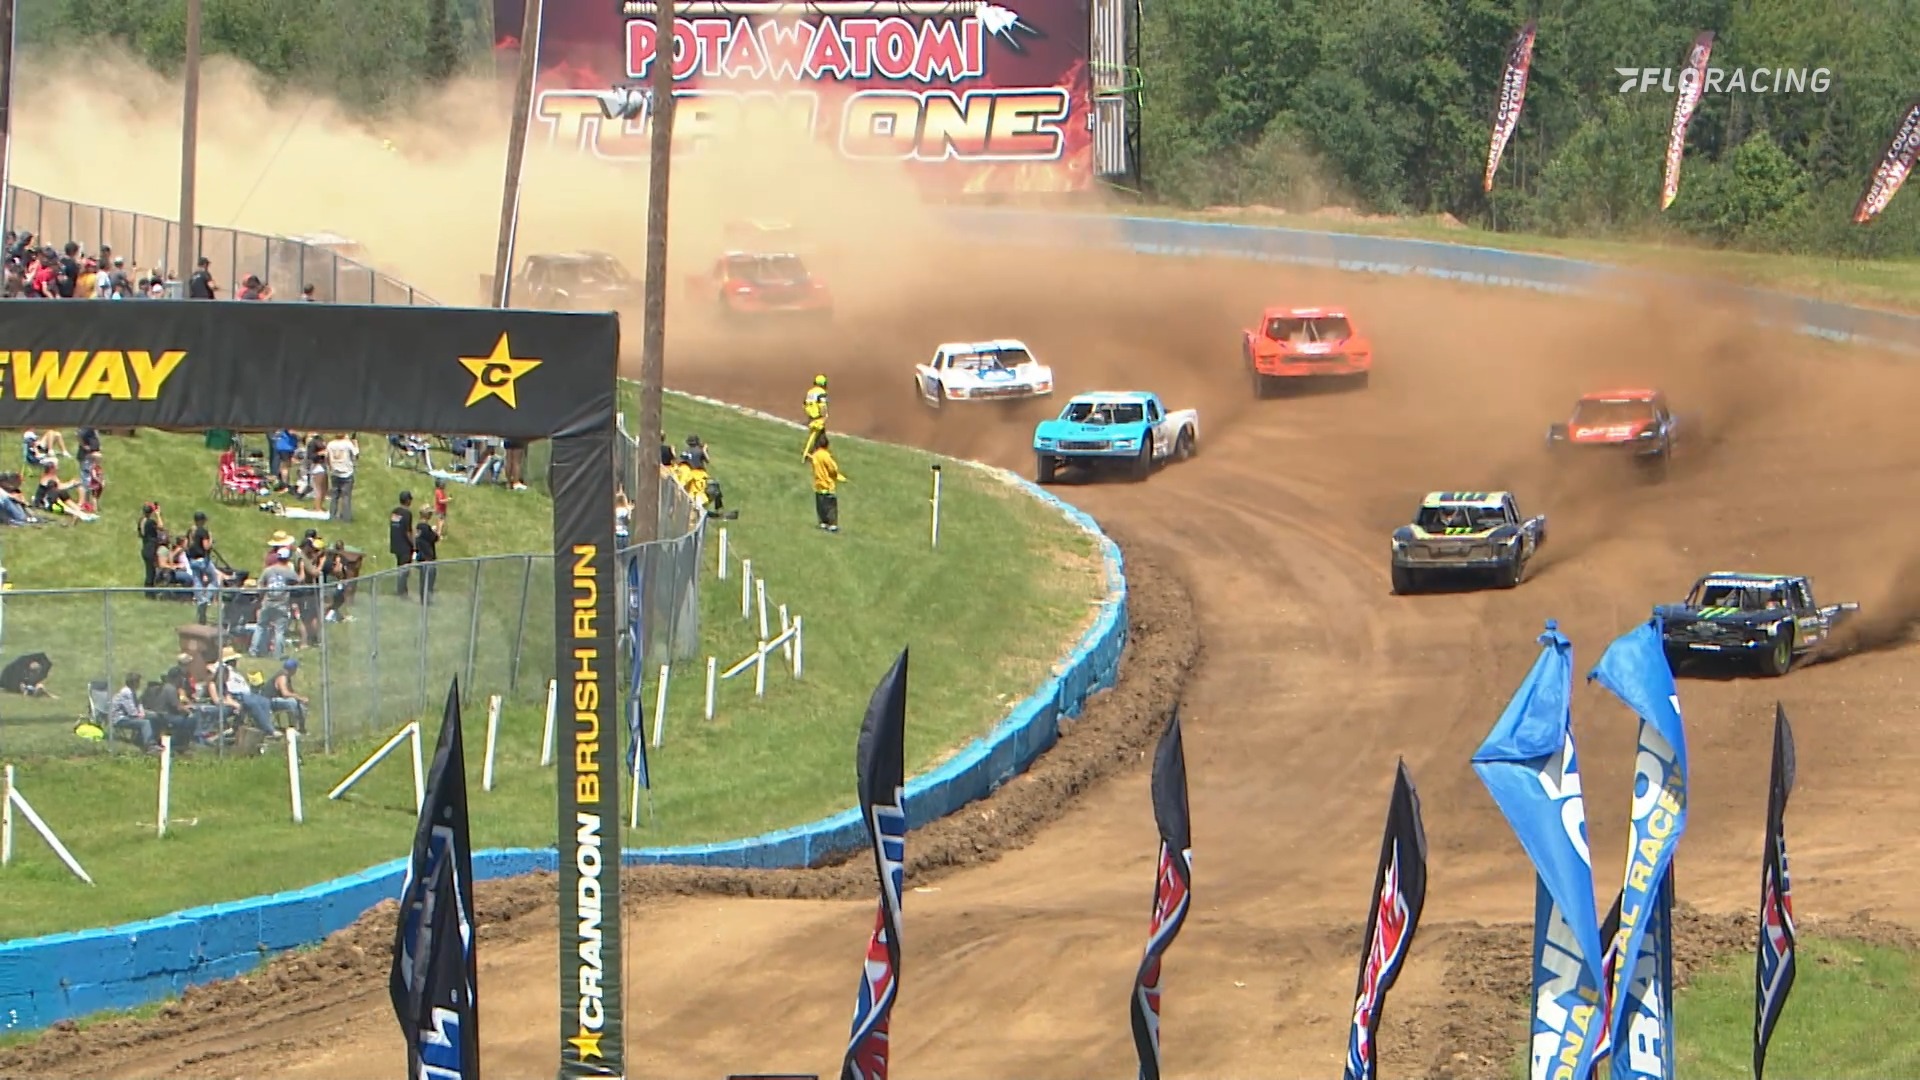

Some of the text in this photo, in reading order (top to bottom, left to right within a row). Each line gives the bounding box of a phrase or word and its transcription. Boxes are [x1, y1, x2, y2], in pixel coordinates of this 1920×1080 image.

[626, 17, 984, 82] POTAWATOMI
[840, 89, 1070, 161] ONE
[572, 544, 605, 1031] CRANDON BRUSH RUN
